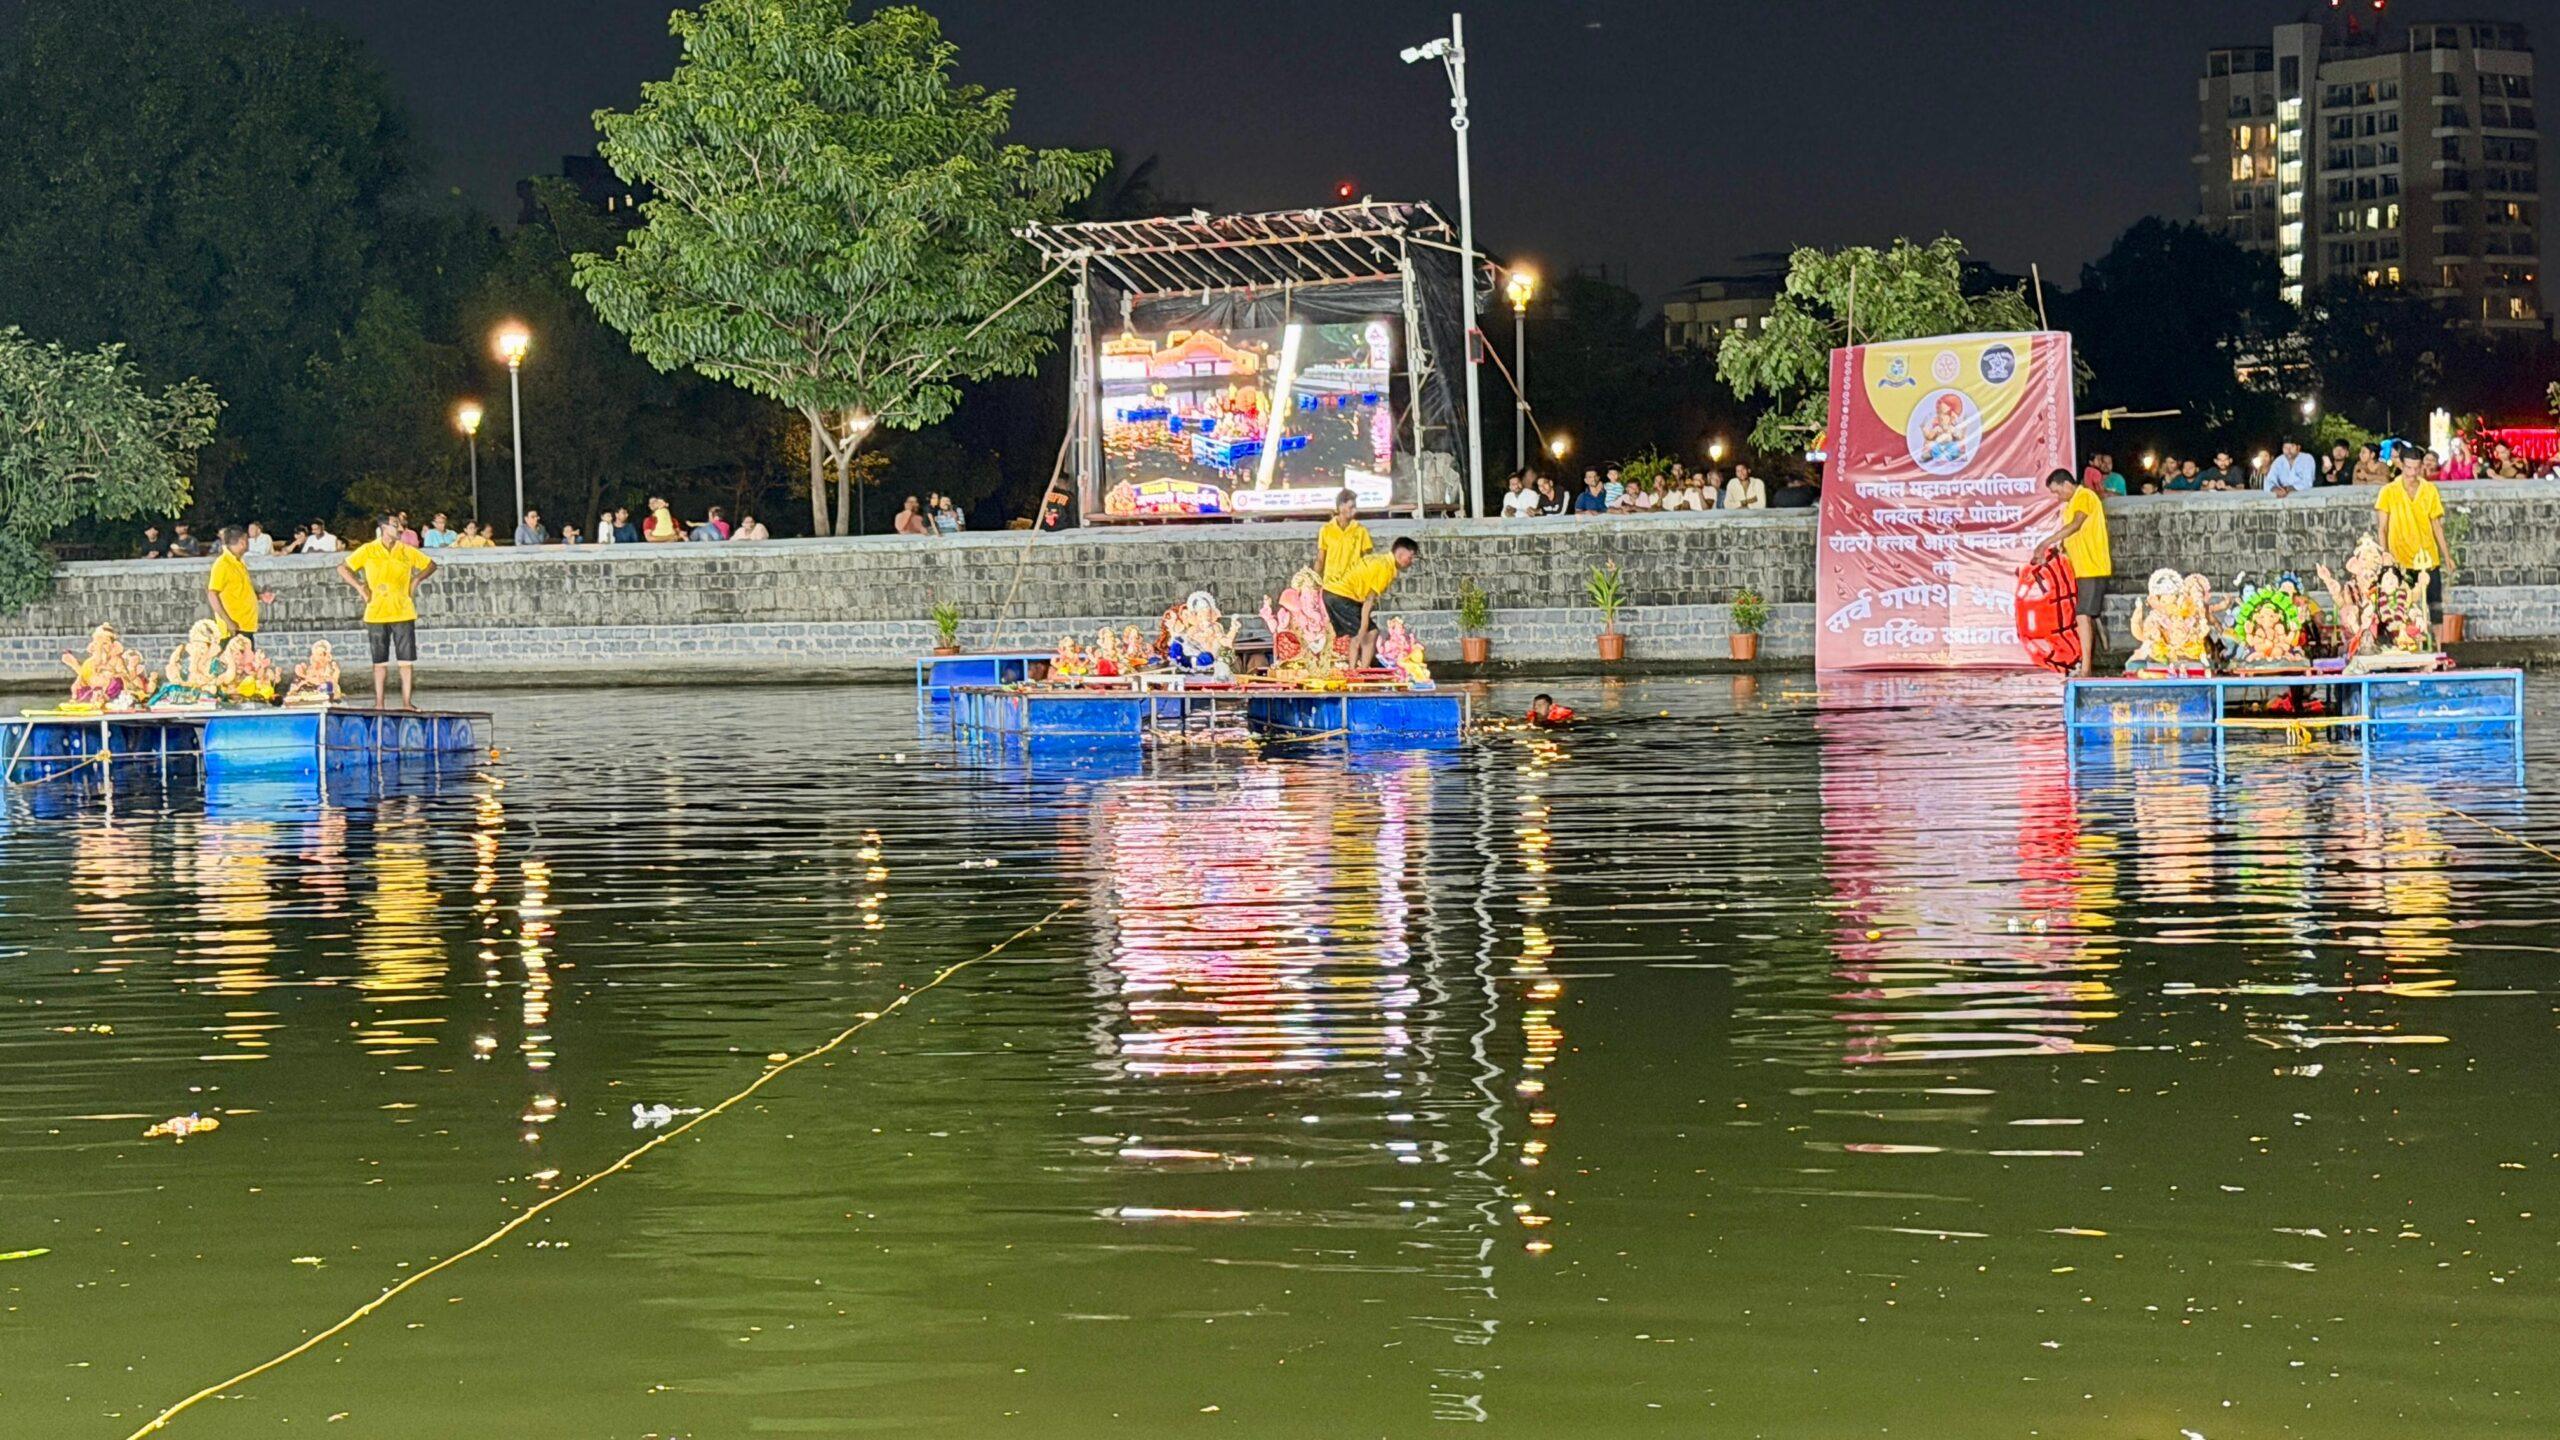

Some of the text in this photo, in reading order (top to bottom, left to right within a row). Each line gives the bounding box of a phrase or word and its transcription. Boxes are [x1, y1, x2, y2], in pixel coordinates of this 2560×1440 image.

[1855, 479, 1905, 499] पनवेल
[1872, 504, 1923, 525] पनवेल
[1927, 507, 1965, 526] शहर
[1825, 588, 1872, 633] सर्व
[1878, 577, 1961, 609] गणेश
[1862, 617, 1938, 648] हार्दिक
